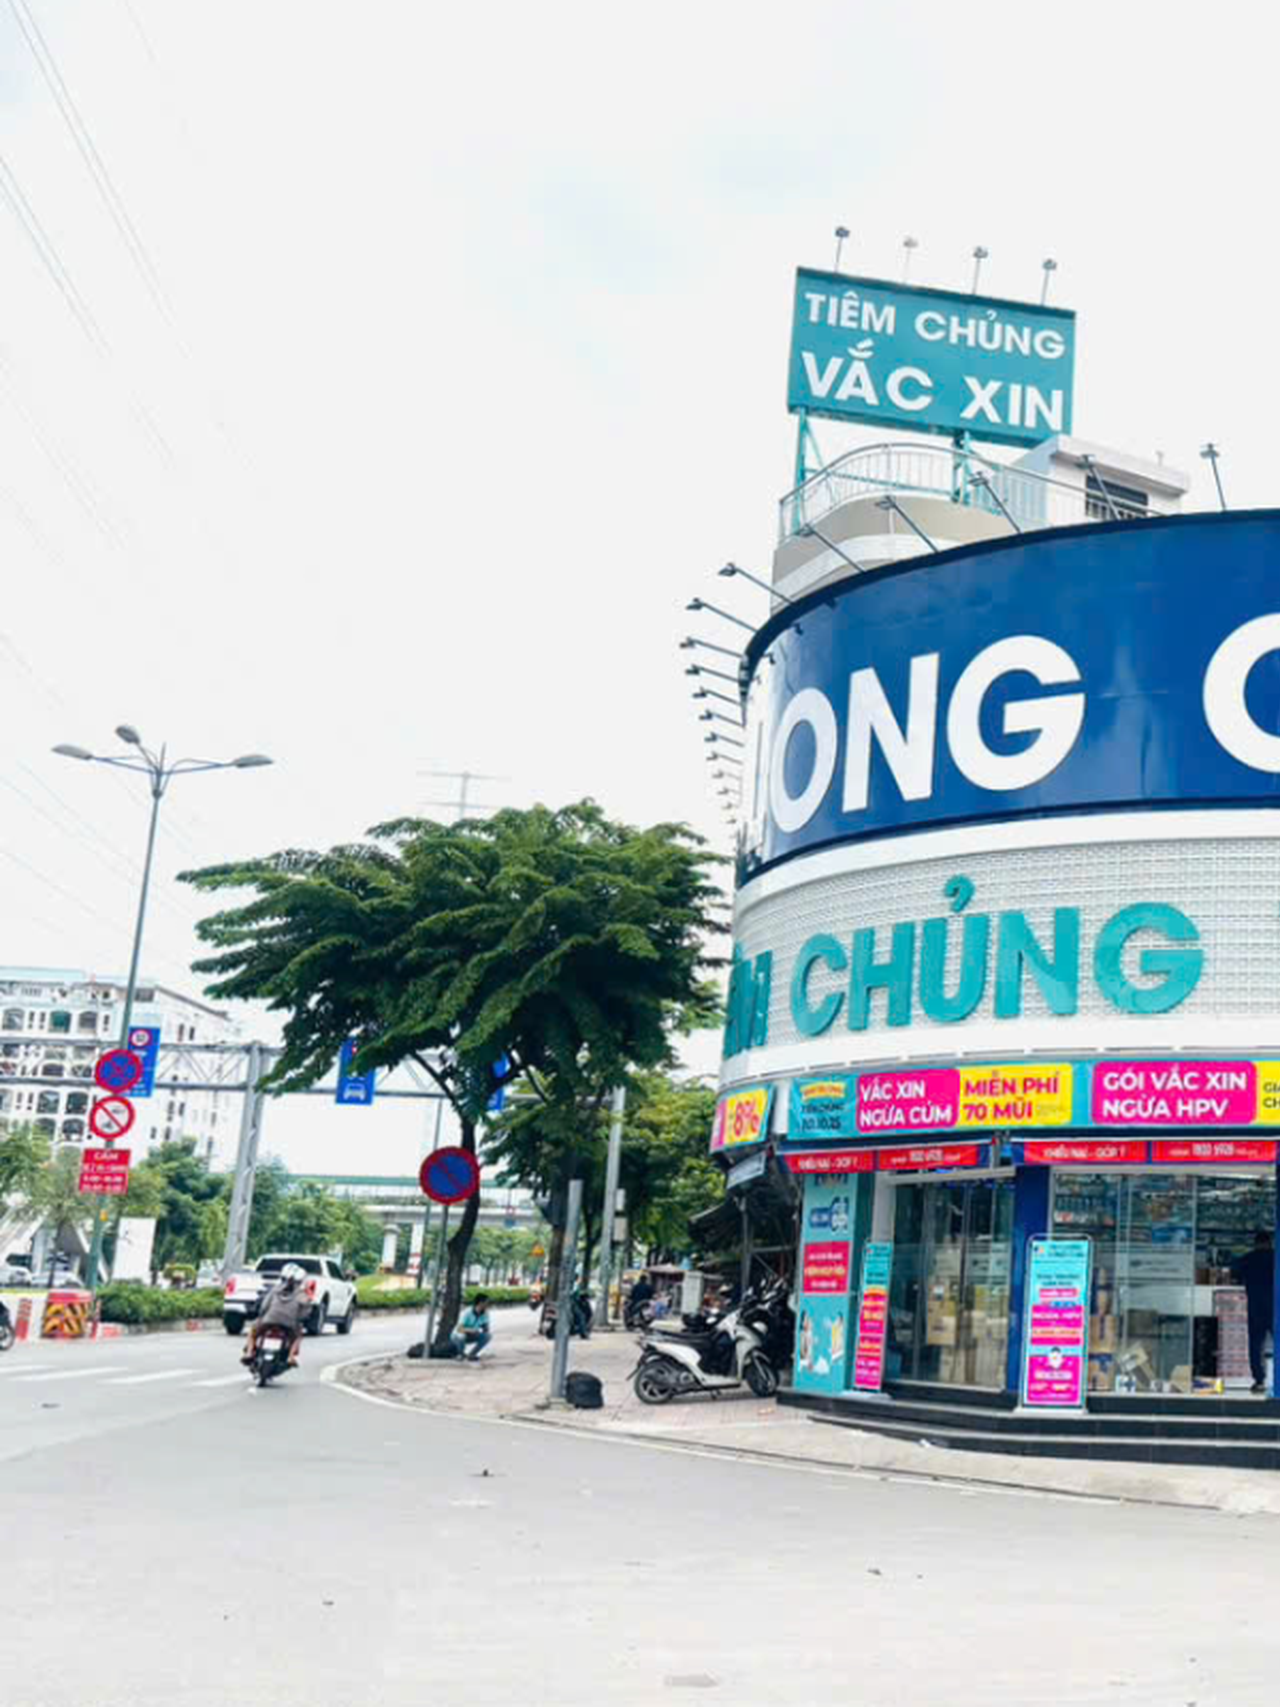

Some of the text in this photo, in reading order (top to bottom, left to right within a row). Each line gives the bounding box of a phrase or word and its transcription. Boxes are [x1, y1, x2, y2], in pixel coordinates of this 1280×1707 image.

[804, 290, 1066, 360] TIÊM CHỦNG
[801, 339, 1064, 431] VẮC XIN
[756, 635, 1086, 834] ONG
[790, 875, 1205, 1037] CHỦNG
[860, 1077, 892, 1101] VẮC
[896, 1080, 925, 1099] XIN
[1023, 1070, 1059, 1095] PHÍ
[1103, 1064, 1248, 1090] GÓI VẮC XIN
[964, 1103, 987, 1121] 70
[993, 1097, 1033, 1120] MŨI
[1103, 1094, 1230, 1117] NGỪA HPV
